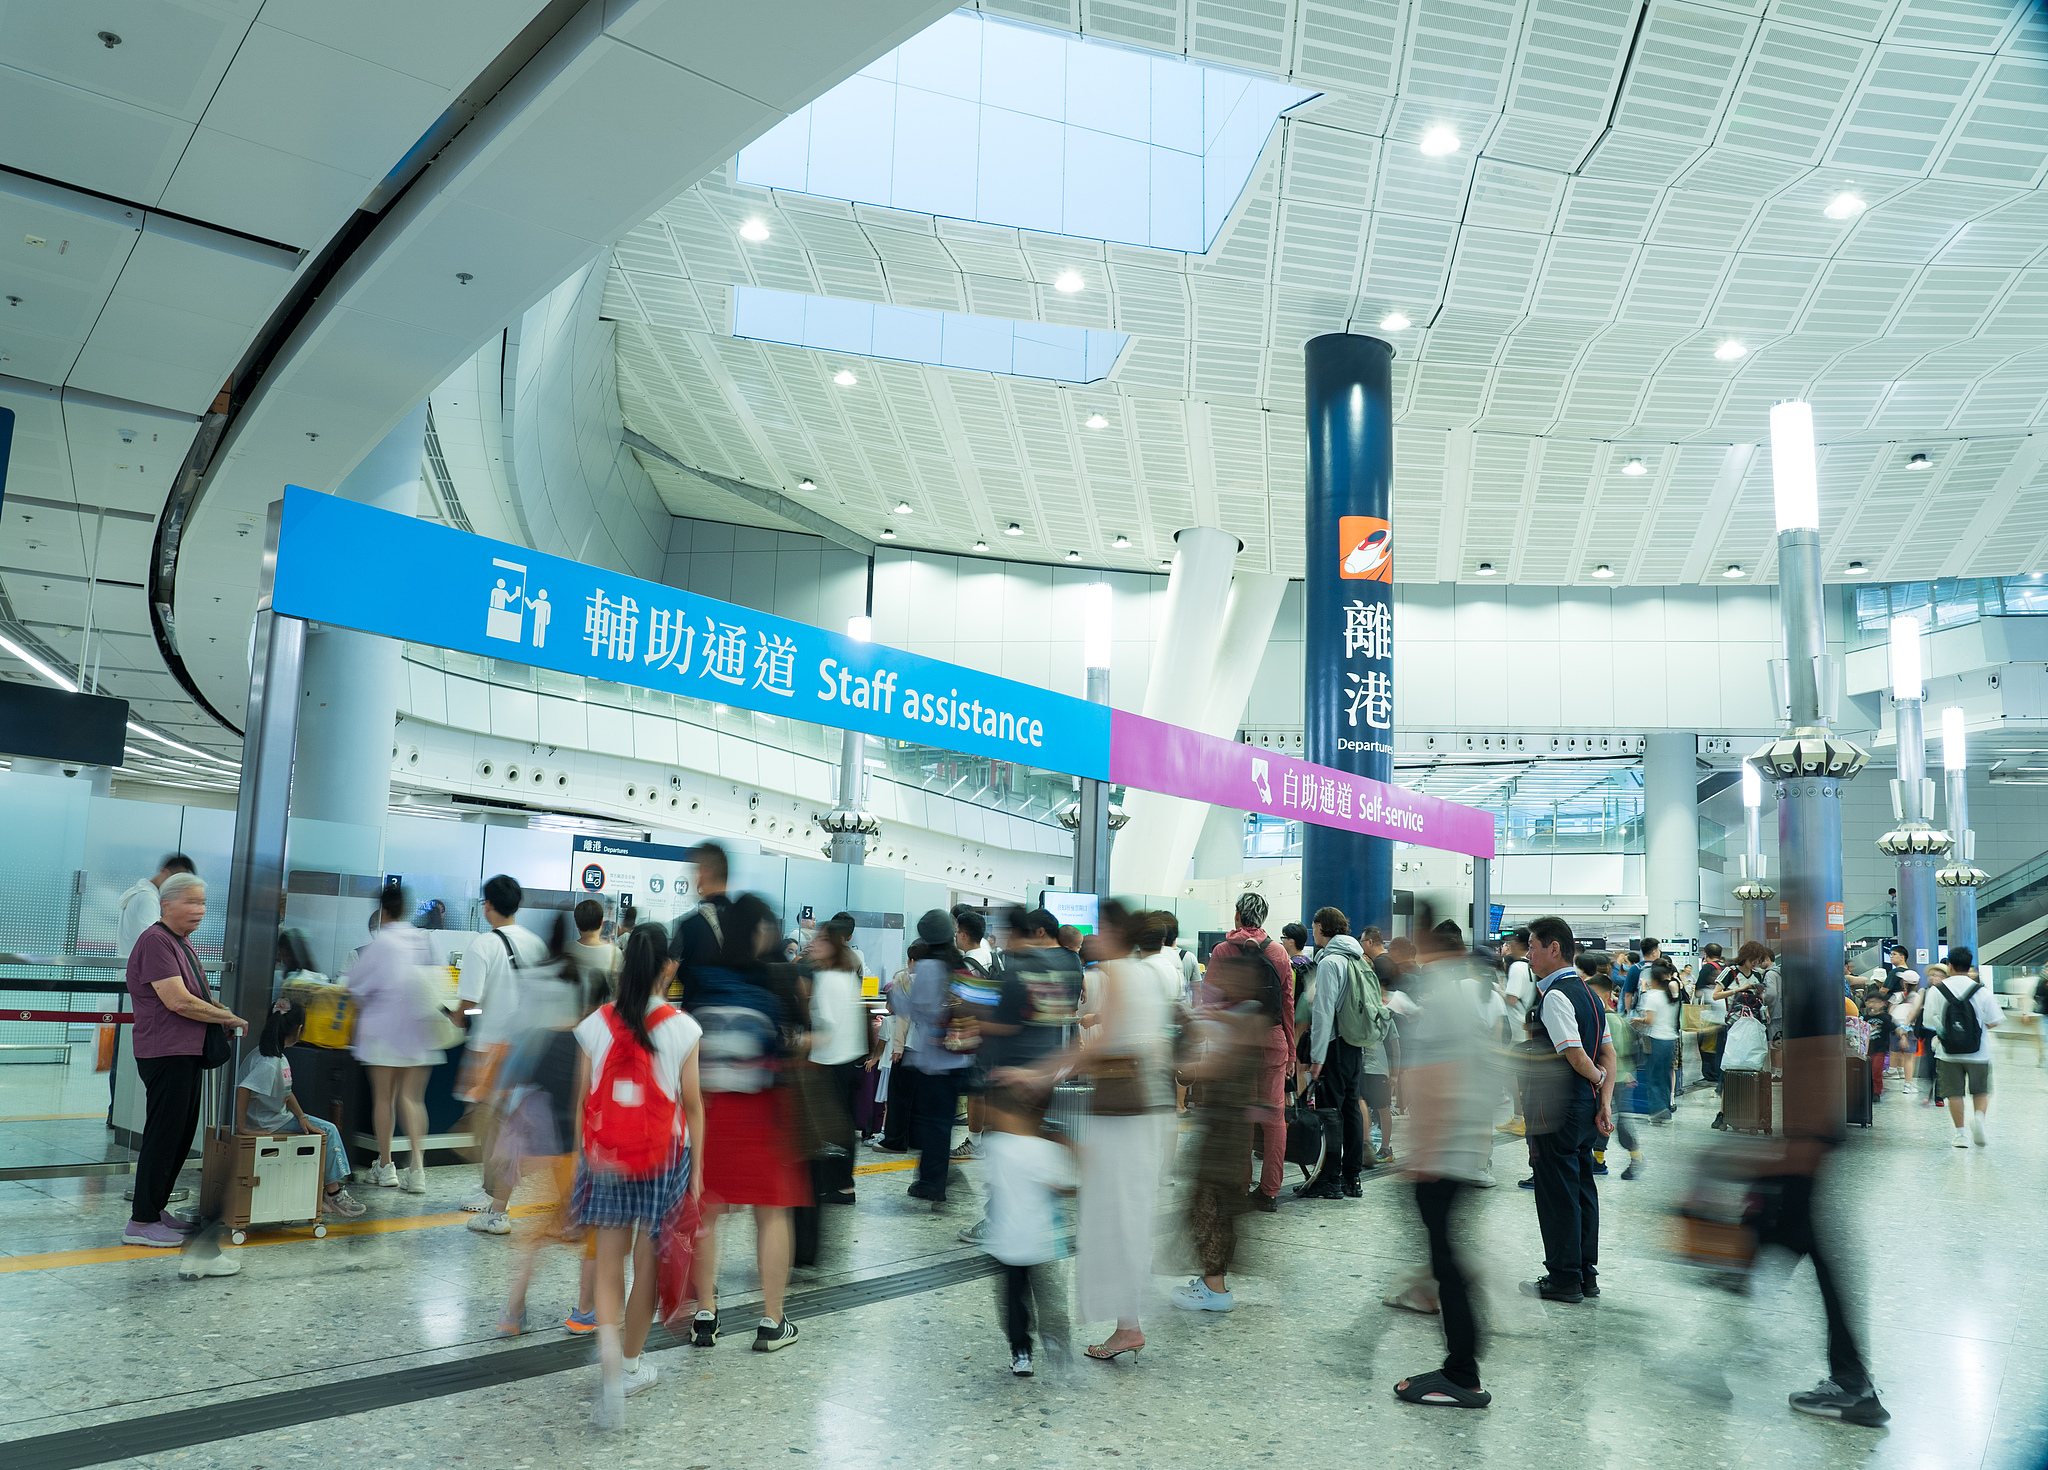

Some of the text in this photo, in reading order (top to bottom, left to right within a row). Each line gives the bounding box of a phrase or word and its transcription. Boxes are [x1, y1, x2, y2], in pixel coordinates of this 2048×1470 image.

[583, 588, 798, 697] 輔助通道
[1343, 600, 1392, 729] 離港
[817, 658, 1043, 747] Staff assistance
[1337, 738, 1394, 755] Departures
[1282, 768, 1353, 820] 自助通道
[1358, 793, 1424, 833] Self-service
[583, 840, 601, 852] 離港
[603, 846, 628, 855] Departures
[622, 896, 629, 906] 4
[806, 908, 811, 918] 5
[1692, 938, 1699, 952] B
